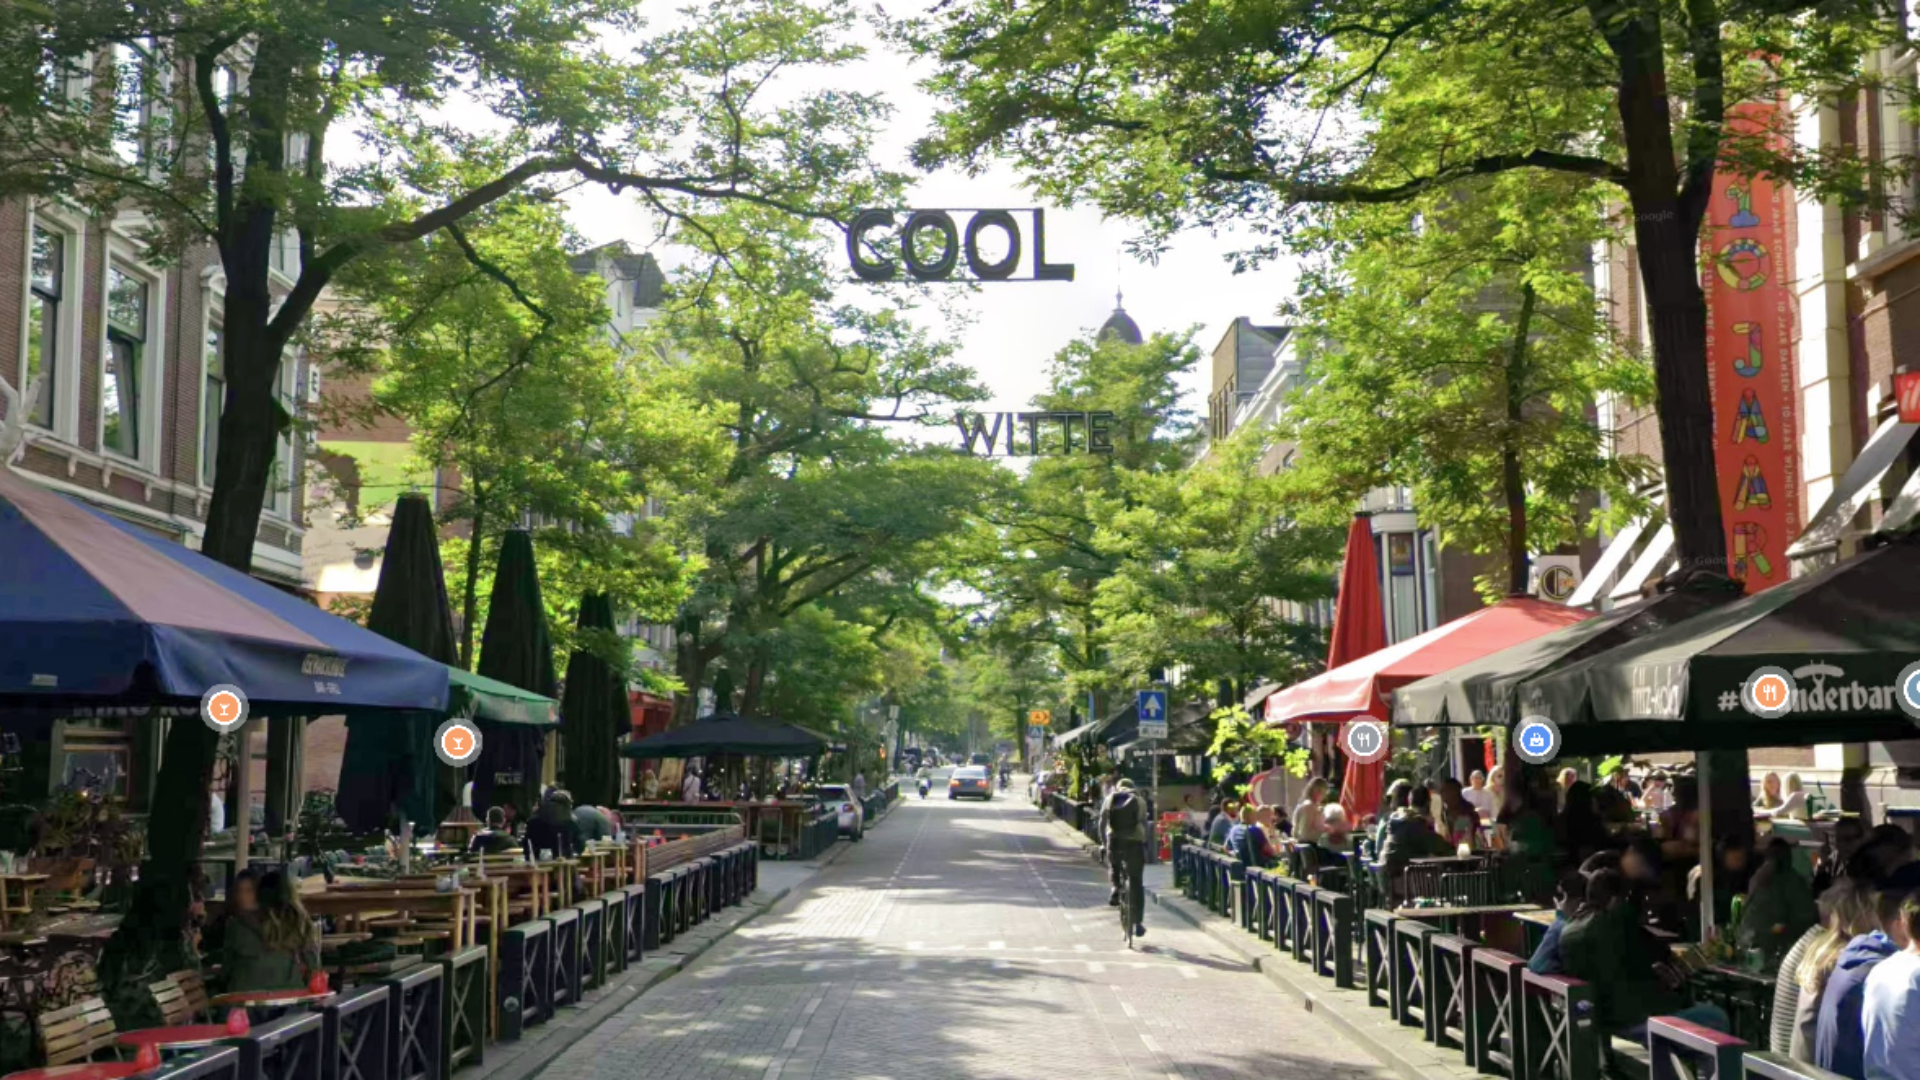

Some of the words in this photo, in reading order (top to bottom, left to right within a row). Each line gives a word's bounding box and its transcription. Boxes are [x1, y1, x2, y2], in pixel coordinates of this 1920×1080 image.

[847, 208, 1075, 281] COOL
[956, 411, 1114, 456] WITTE
[1730, 319, 1773, 579] JAAR
